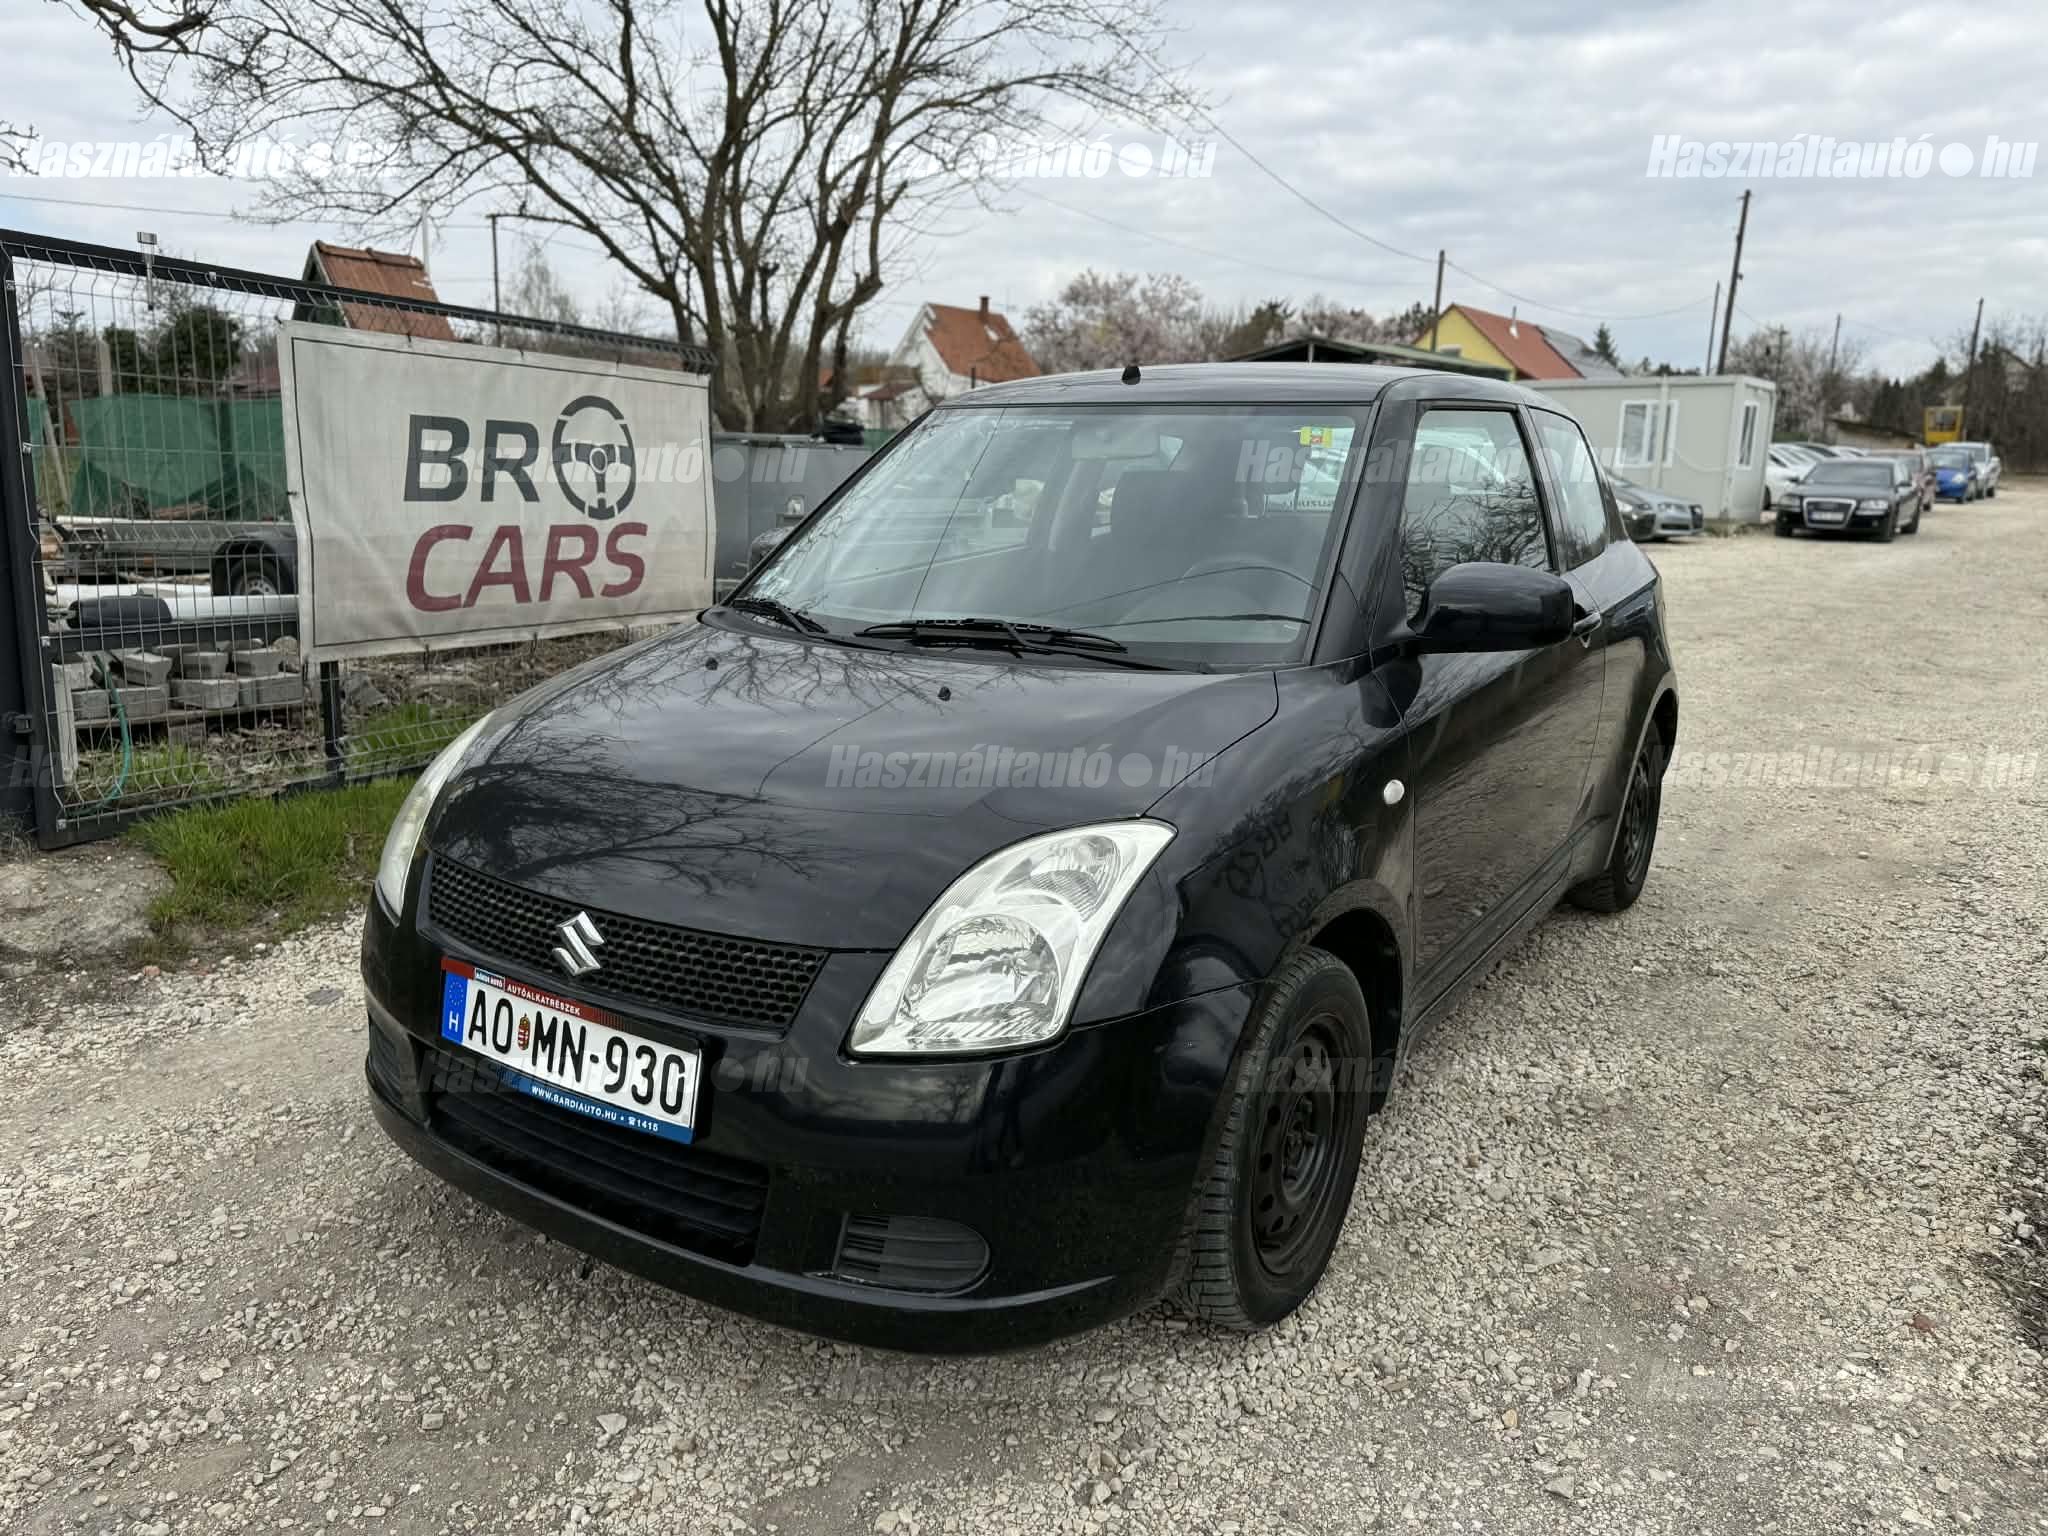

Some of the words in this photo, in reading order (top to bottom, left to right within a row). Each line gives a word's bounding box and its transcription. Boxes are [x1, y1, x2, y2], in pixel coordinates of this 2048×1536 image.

[405, 523, 648, 612] CARS
[449, 1011, 459, 1034] H
[468, 989, 513, 1054] AO
[532, 1011, 686, 1115] MN-930
[637, 1119, 659, 1132] 1415
